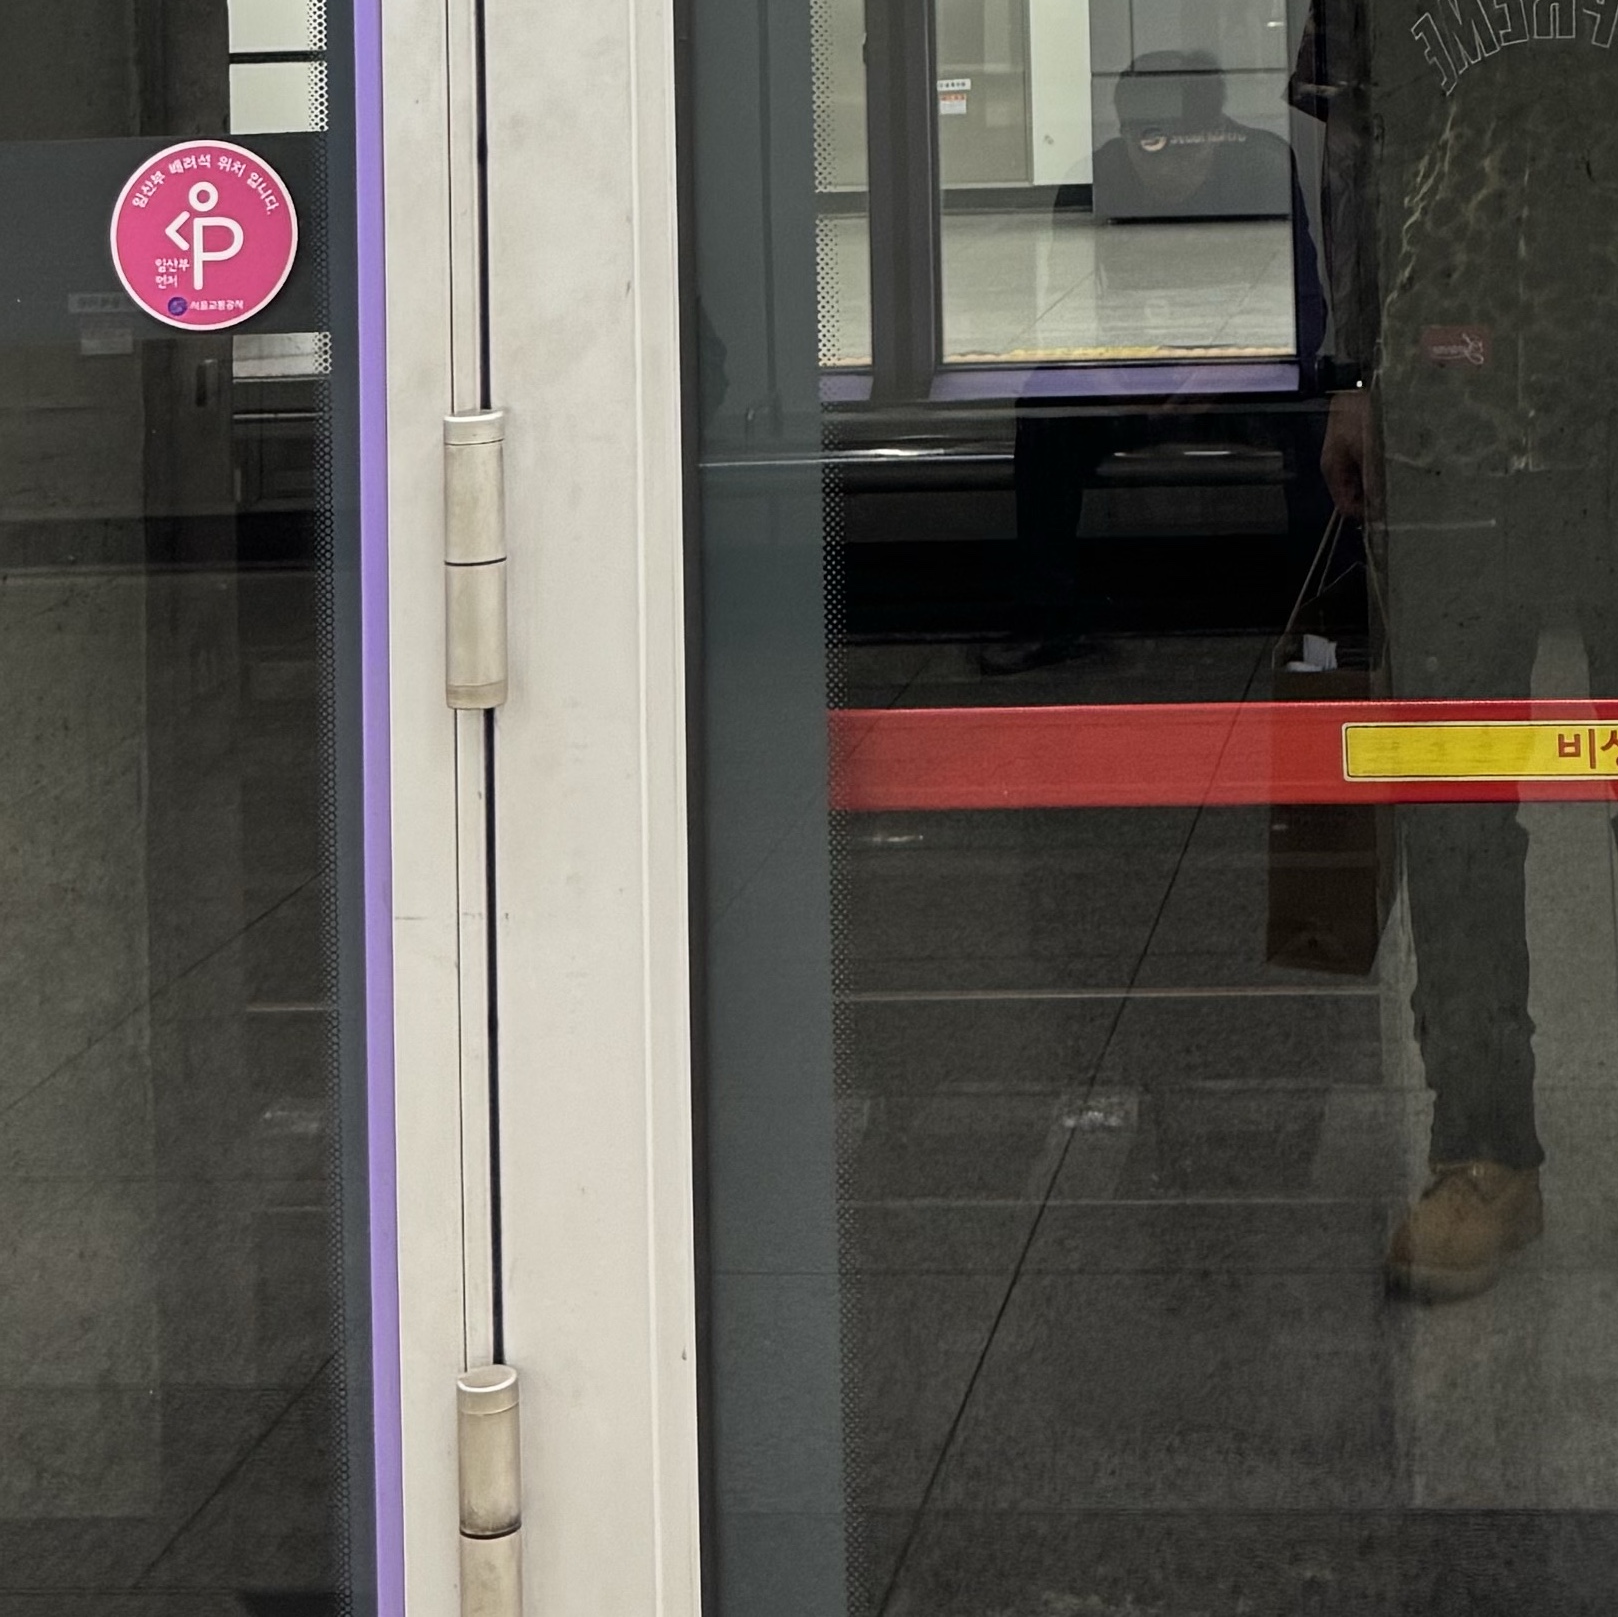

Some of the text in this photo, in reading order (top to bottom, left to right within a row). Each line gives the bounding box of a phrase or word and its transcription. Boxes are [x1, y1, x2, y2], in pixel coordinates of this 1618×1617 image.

[131, 170, 166, 208] 임산부
[168, 153, 212, 174] 배려석
[217, 155, 247, 178] 위치
